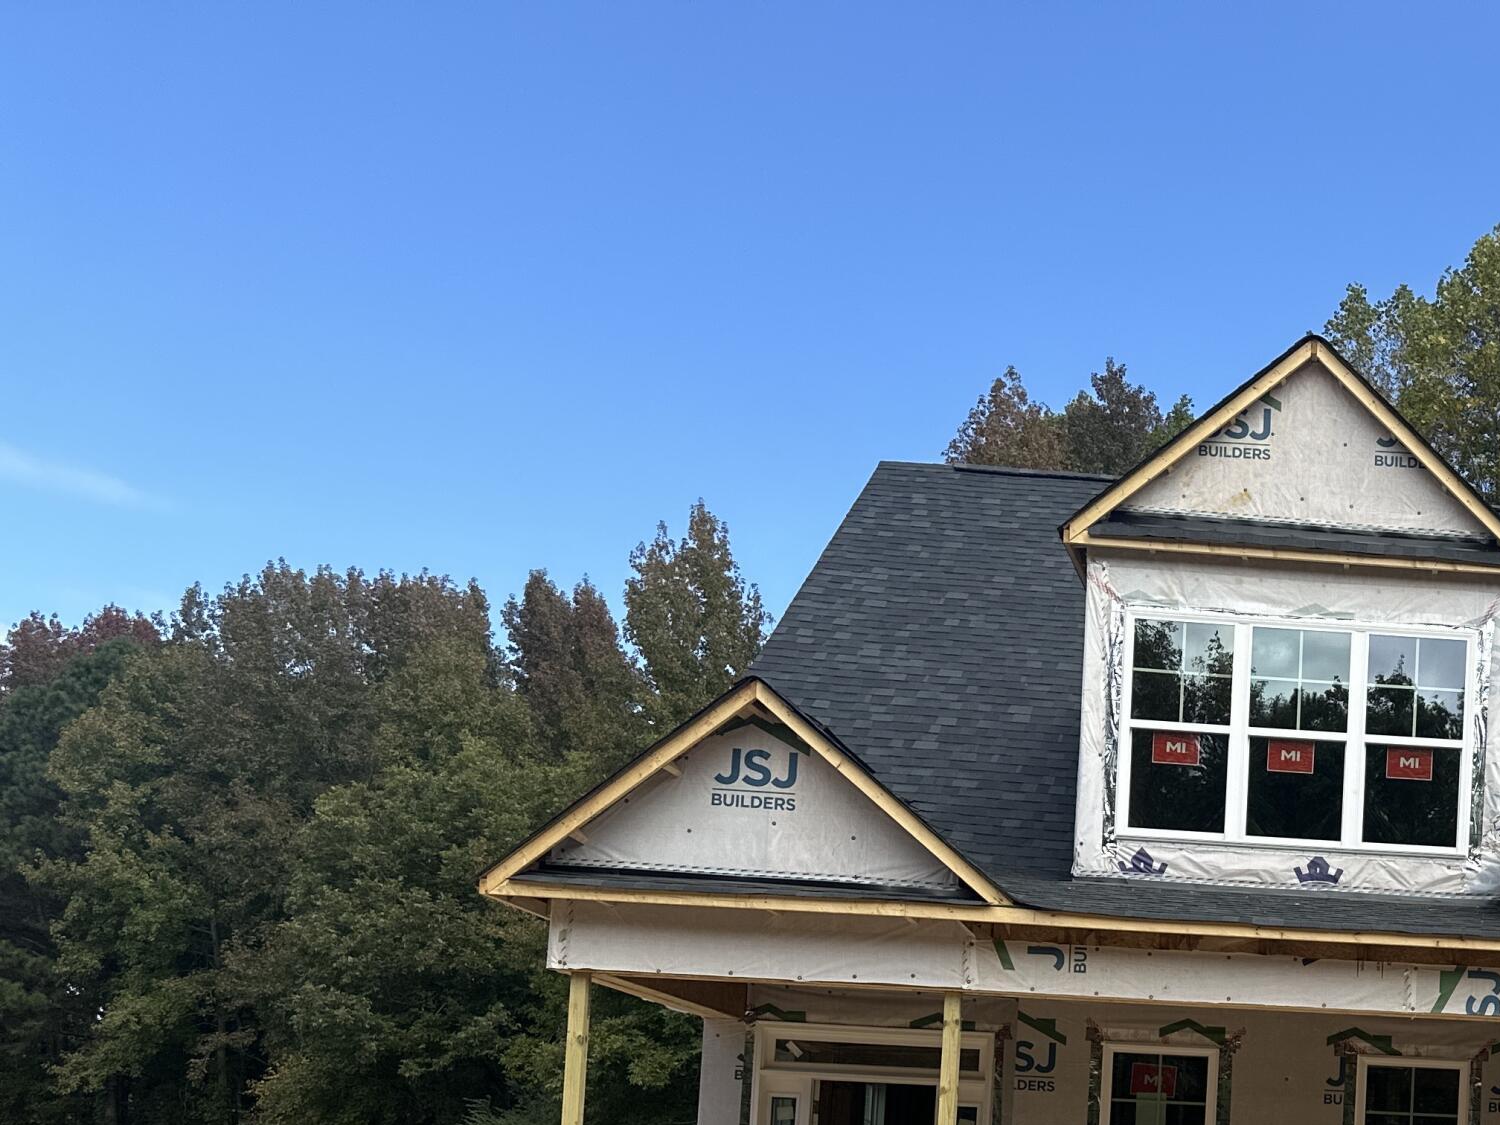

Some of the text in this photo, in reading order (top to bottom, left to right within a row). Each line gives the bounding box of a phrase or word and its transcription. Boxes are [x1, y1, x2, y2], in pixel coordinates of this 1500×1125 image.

[1209, 407, 1271, 441] SJ
[1198, 445, 1271, 460] BUILDERS
[1165, 741, 1186, 754] MI
[1280, 750, 1301, 762] MI
[1399, 757, 1420, 769] MI
[713, 748, 799, 789] JSJ
[711, 793, 796, 811] BUILDERS
